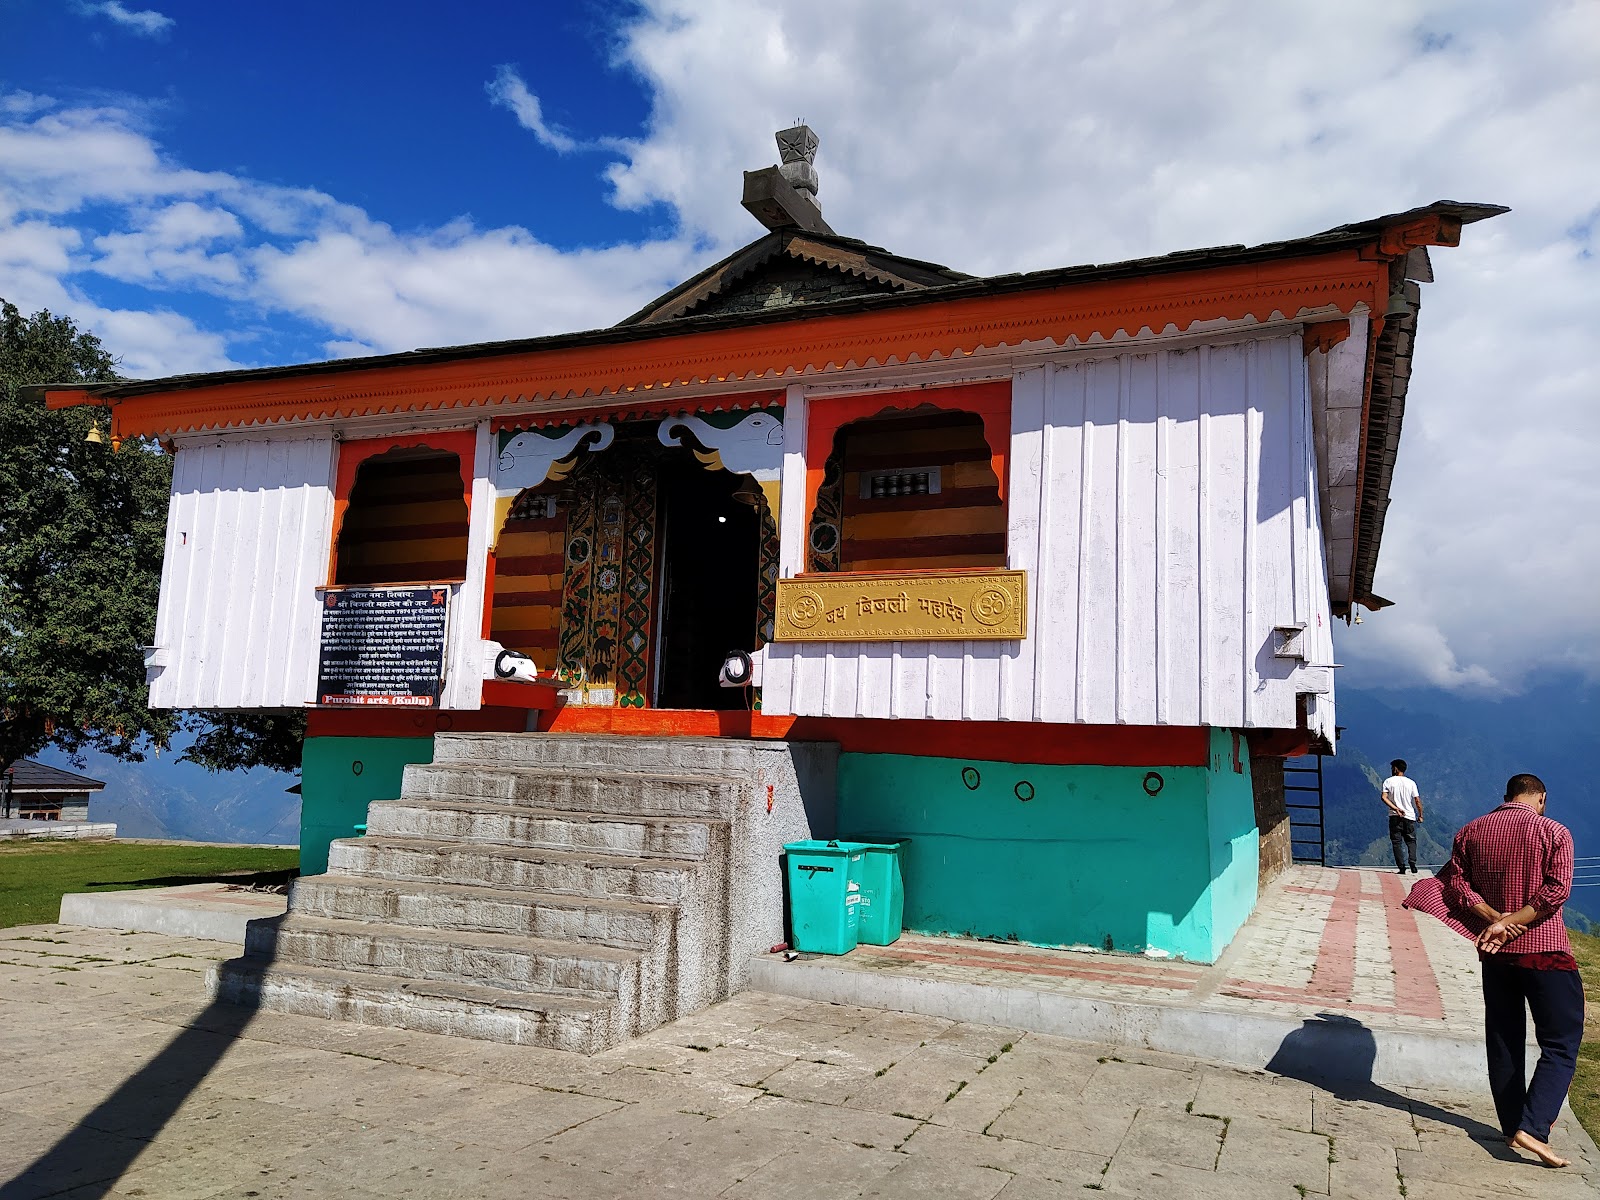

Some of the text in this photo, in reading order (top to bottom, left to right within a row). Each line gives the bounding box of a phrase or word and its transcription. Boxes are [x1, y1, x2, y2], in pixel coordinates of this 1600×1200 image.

[825, 591, 967, 624] जय बिजली महादेव
[325, 695, 430, 706] Purohit arts (Kullu)
